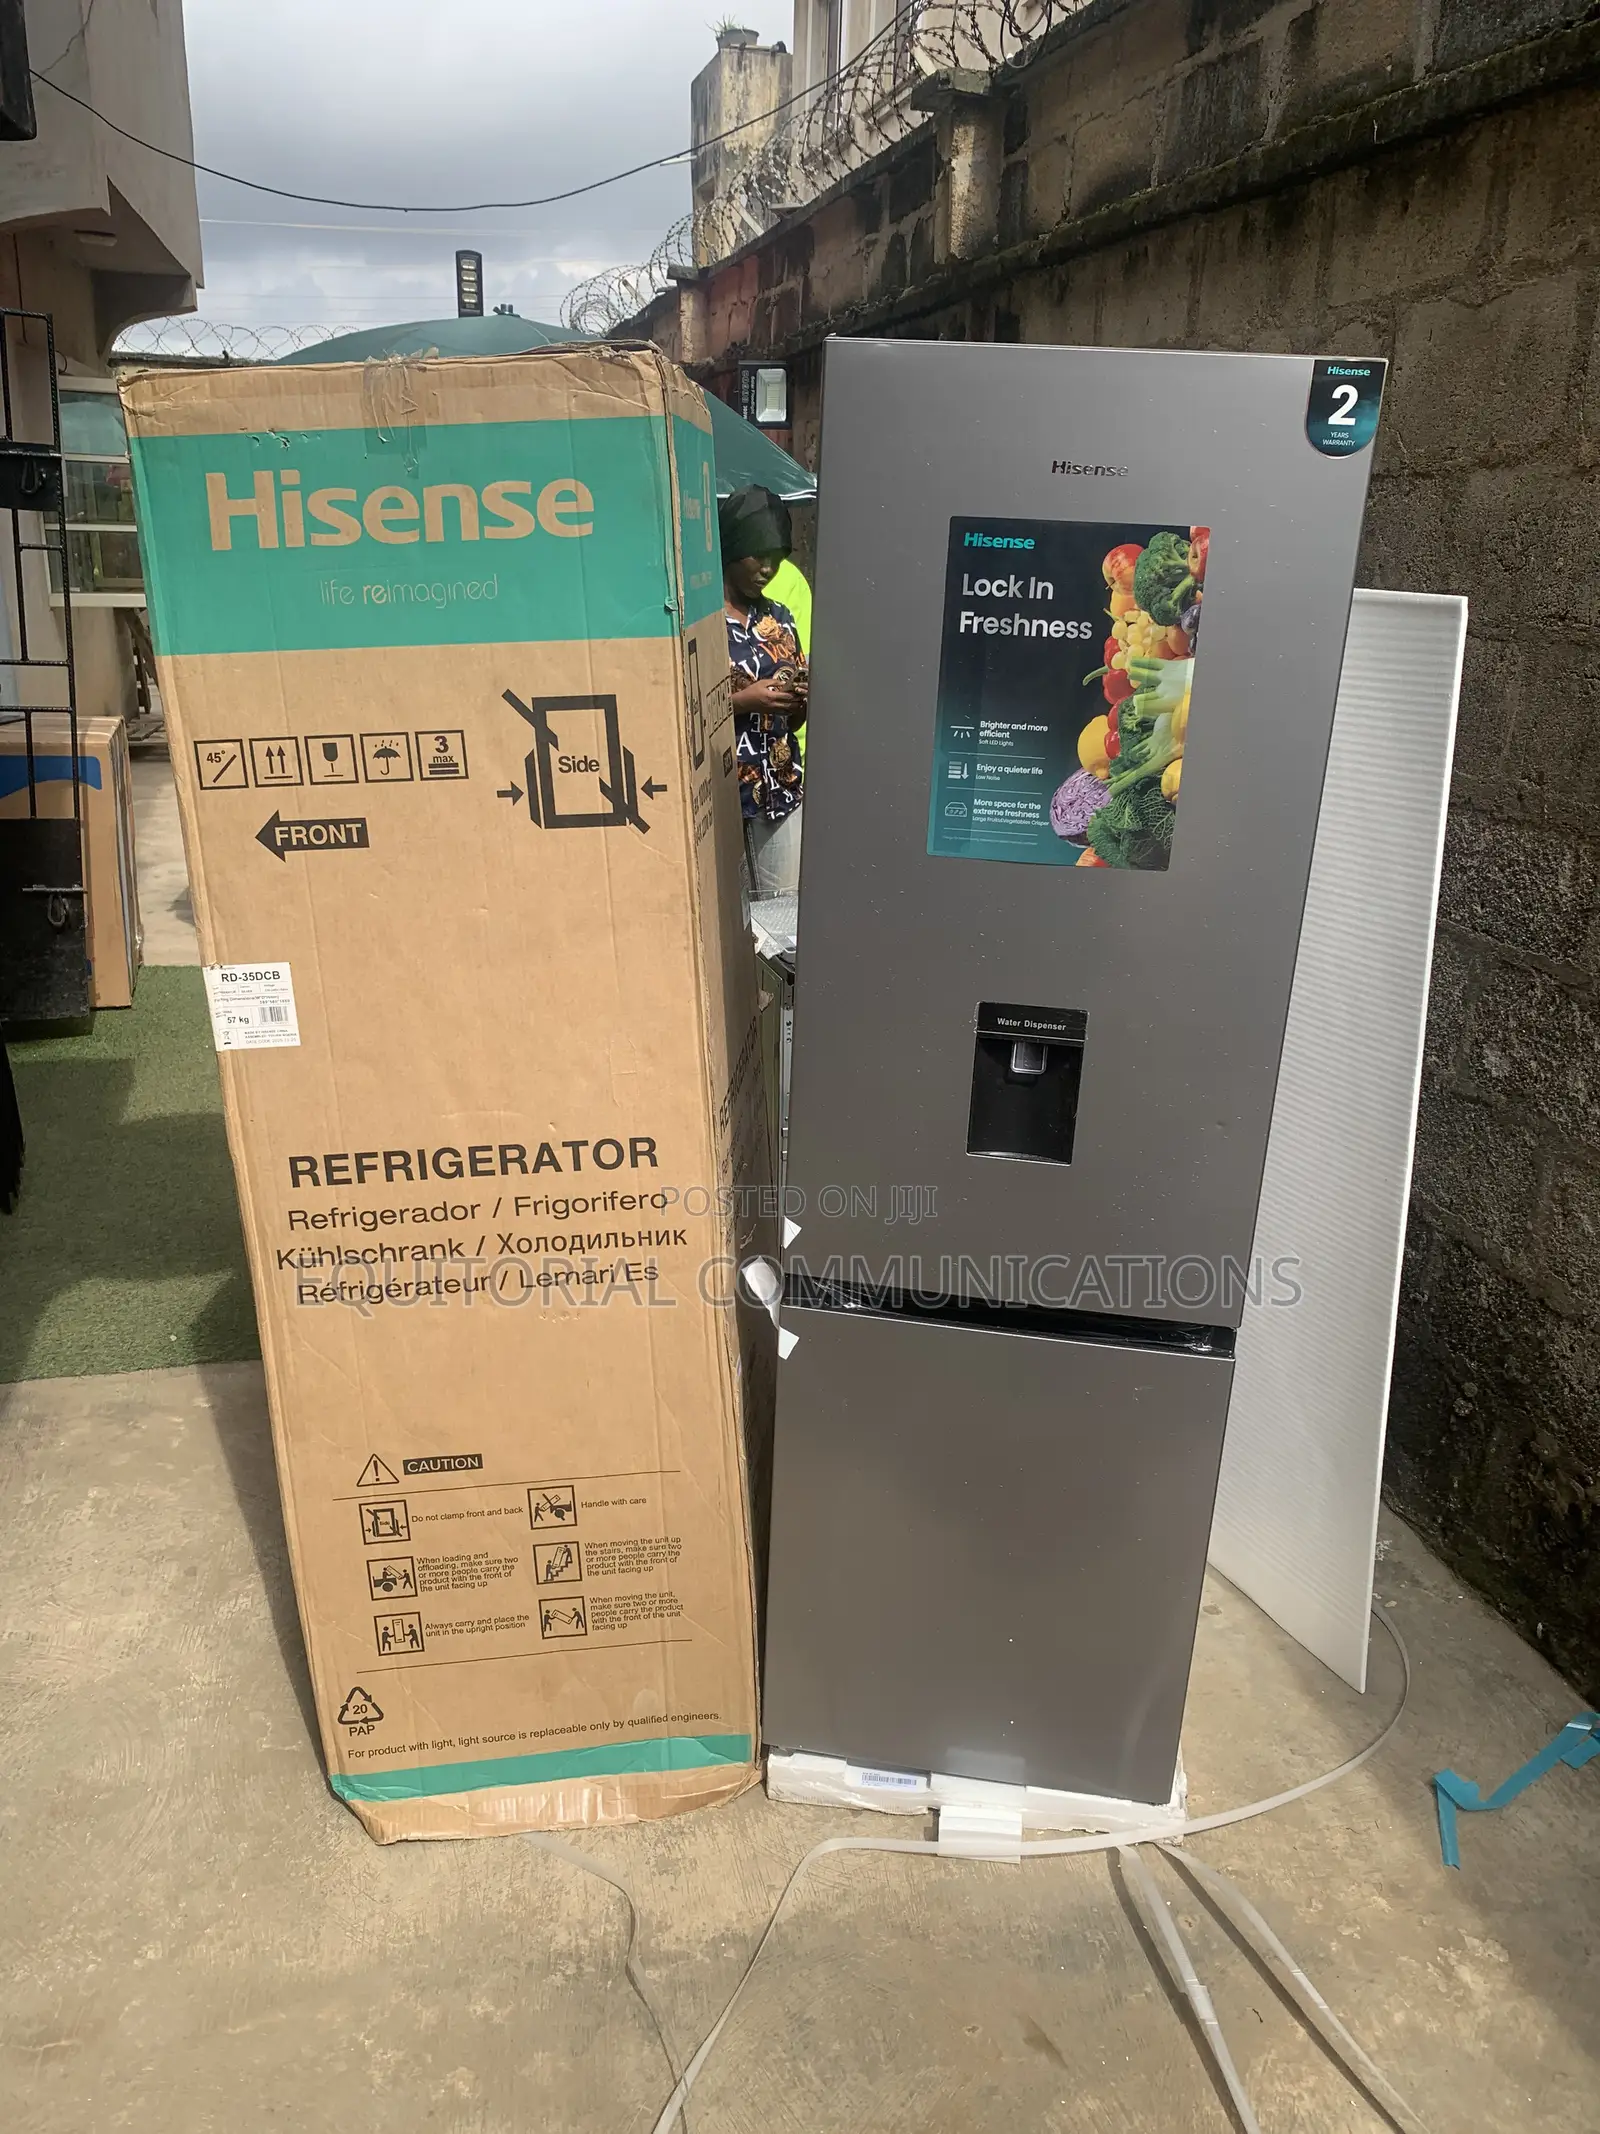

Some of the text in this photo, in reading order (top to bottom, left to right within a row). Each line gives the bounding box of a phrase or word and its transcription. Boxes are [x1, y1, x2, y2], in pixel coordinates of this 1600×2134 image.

[1327, 366, 1371, 376] Hisense
[1328, 384, 1358, 426] 2
[1052, 460, 1128, 478] Hisense
[205, 468, 595, 552] Hisense
[964, 533, 1035, 550] Hisense
[320, 573, 498, 609] life reimagined
[962, 572, 1054, 600] Lock In
[959, 611, 1093, 641] Freshness
[980, 720, 1010, 730] Brighter
[979, 730, 1010, 738] efficient
[434, 736, 450, 754] 3
[206, 750, 226, 766] 45°
[432, 754, 455, 764] max
[558, 754, 600, 775] Side
[976, 764, 997, 773] Enjoy
[1004, 766, 1030, 774] quieter
[1032, 767, 1044, 775] life
[974, 798, 992, 806] More
[994, 801, 1016, 809] space
[973, 808, 1040, 818] extreme freshness
[274, 822, 362, 848] FRONT
[221, 971, 280, 982] RD-35DCB
[239, 1016, 250, 1024] kg
[996, 1017, 1066, 1032] Water Dispenser
[288, 1136, 660, 1190] REFRIGERATOR
[287, 1189, 668, 1232] Refrigerador Frigorifero
[496, 1229, 688, 1258] Холодильник
[276, 1236, 466, 1270] Kühlschrank
[298, 1263, 660, 1305] Réfrigérateur Lemari Es
[407, 1456, 480, 1474] CAUTION
[581, 1500, 609, 1508] Handle
[440, 1512, 464, 1520] clamp
[487, 1508, 502, 1516] and
[504, 1506, 524, 1515] back
[584, 1542, 608, 1550] When
[610, 1540, 638, 1548] moving
[600, 1547, 624, 1555] stairs,
[416, 1557, 440, 1565] When
[442, 1554, 472, 1564] loading
[618, 1552, 646, 1561] people
[647, 1550, 667, 1558] carry
[418, 1563, 458, 1572] offloading,
[451, 1568, 478, 1577] people
[480, 1566, 500, 1574] carry
[586, 1561, 616, 1571] product
[618, 1559, 634, 1567] with
[618, 1566, 642, 1574] facing
[420, 1576, 449, 1586] product
[452, 1575, 468, 1583] with
[420, 1584, 433, 1592] the
[436, 1583, 450, 1591] unit
[452, 1581, 476, 1590] facing
[614, 1594, 643, 1602] moving
[425, 1622, 454, 1631] Always
[455, 1620, 476, 1628] carry
[494, 1616, 515, 1625] place
[426, 1630, 441, 1638] unit
[451, 1627, 464, 1635] the
[466, 1624, 494, 1634] upright
[495, 1622, 526, 1632] position
[352, 1704, 368, 1716] 20
[348, 1724, 376, 1738] PAP
[348, 1712, 722, 1759] For product with light, light source is replaceable only by qualified engineers.
